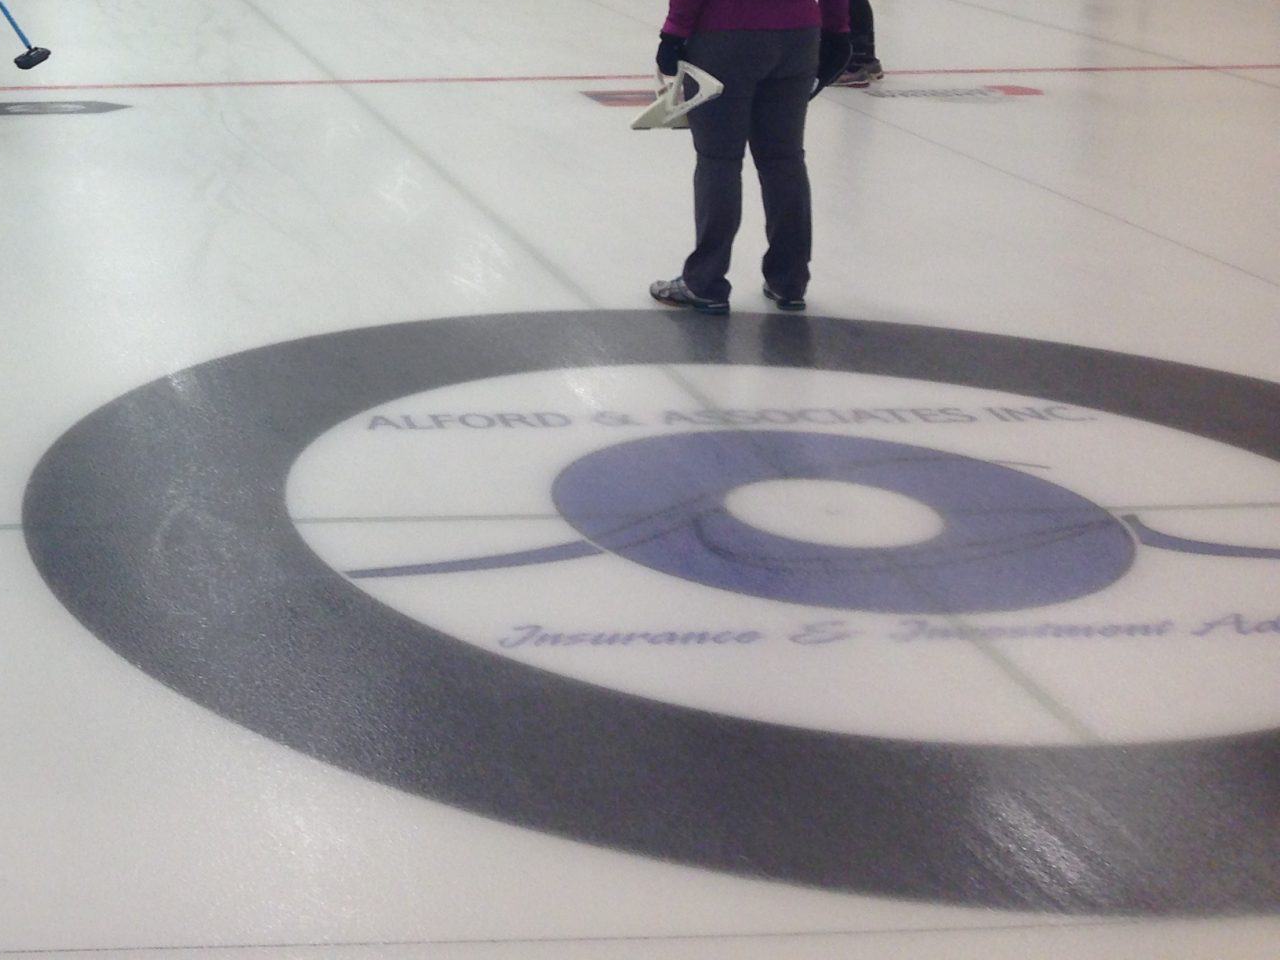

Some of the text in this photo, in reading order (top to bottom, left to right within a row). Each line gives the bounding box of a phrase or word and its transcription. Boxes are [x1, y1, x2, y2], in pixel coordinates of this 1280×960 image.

[368, 412, 574, 430] ALFORD
[663, 407, 978, 426] ASSOCIATES
[983, 406, 1097, 423] INC.
[498, 624, 762, 649] Insurance
